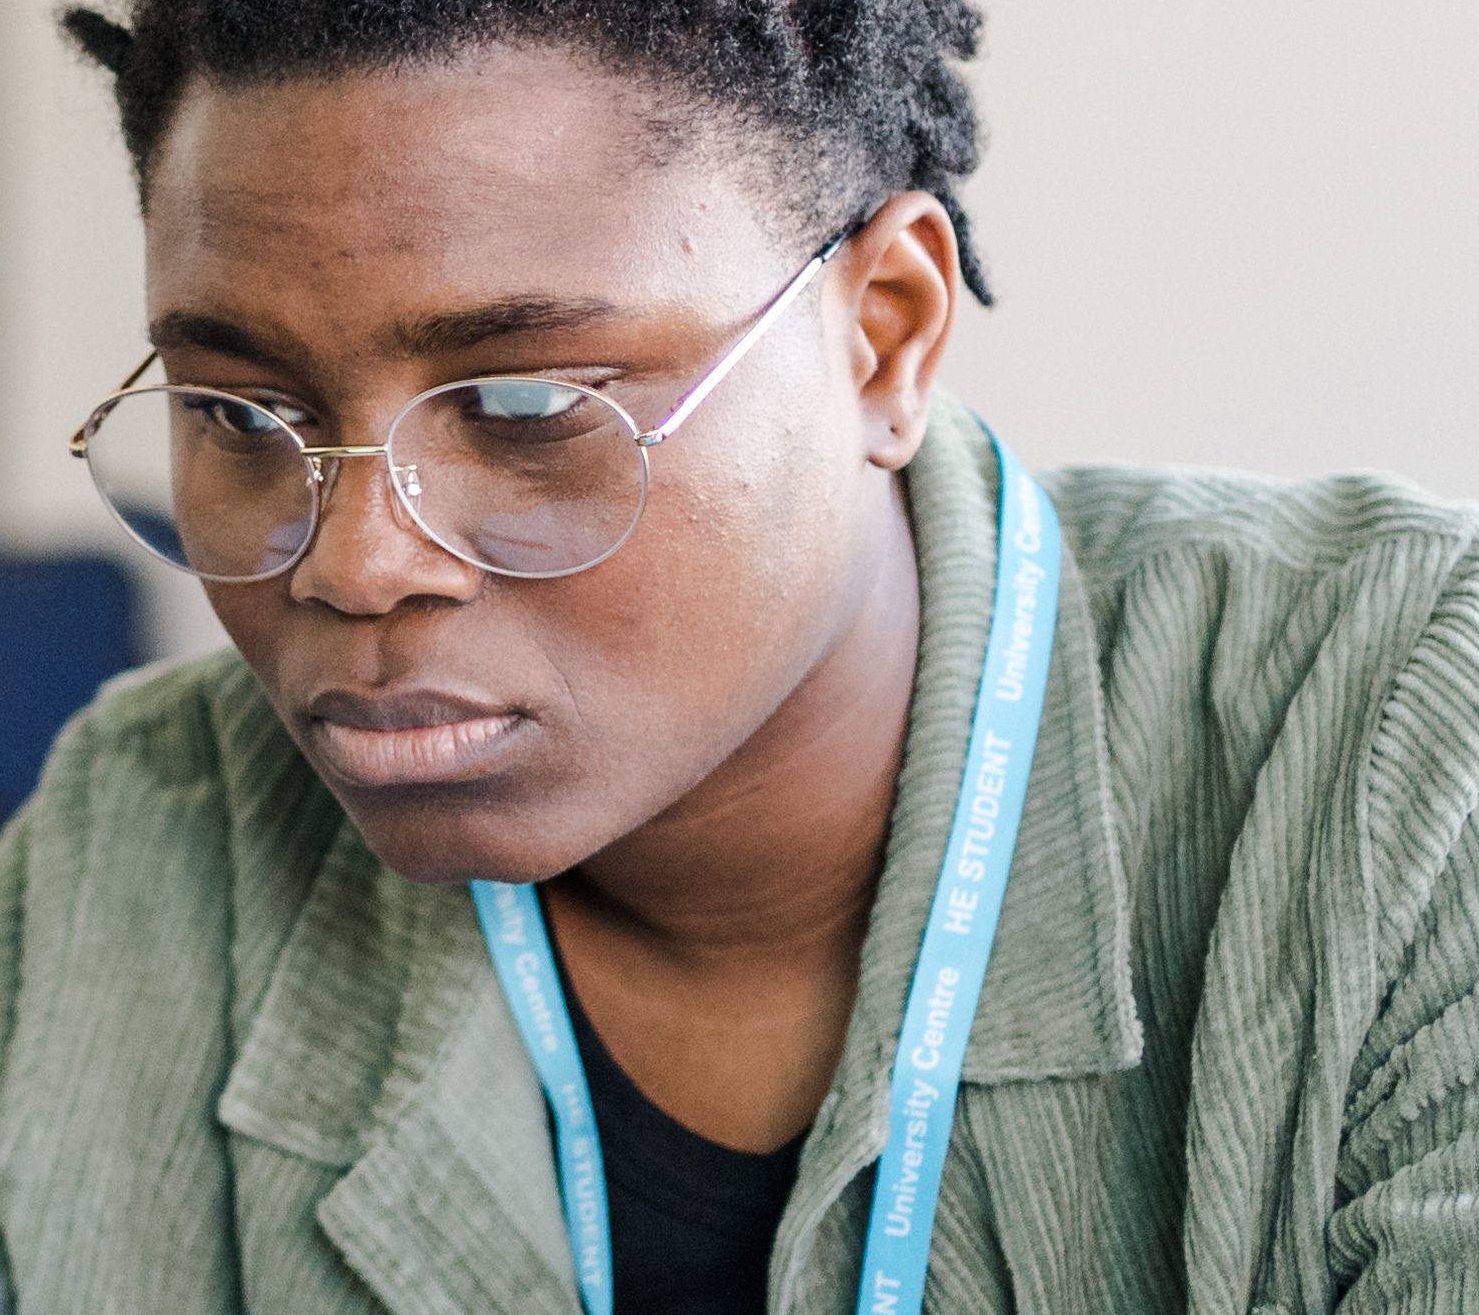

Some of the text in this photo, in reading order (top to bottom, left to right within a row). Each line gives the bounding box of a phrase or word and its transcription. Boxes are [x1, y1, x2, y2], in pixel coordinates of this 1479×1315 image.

[994, 557, 1046, 701] University
[957, 729, 1012, 882] STUDENT
[943, 886, 979, 934] HE
[911, 965, 960, 1071] Centre
[515, 950, 558, 1052] Centre
[573, 1137, 601, 1285] STUDENT
[884, 1078, 940, 1237] University
